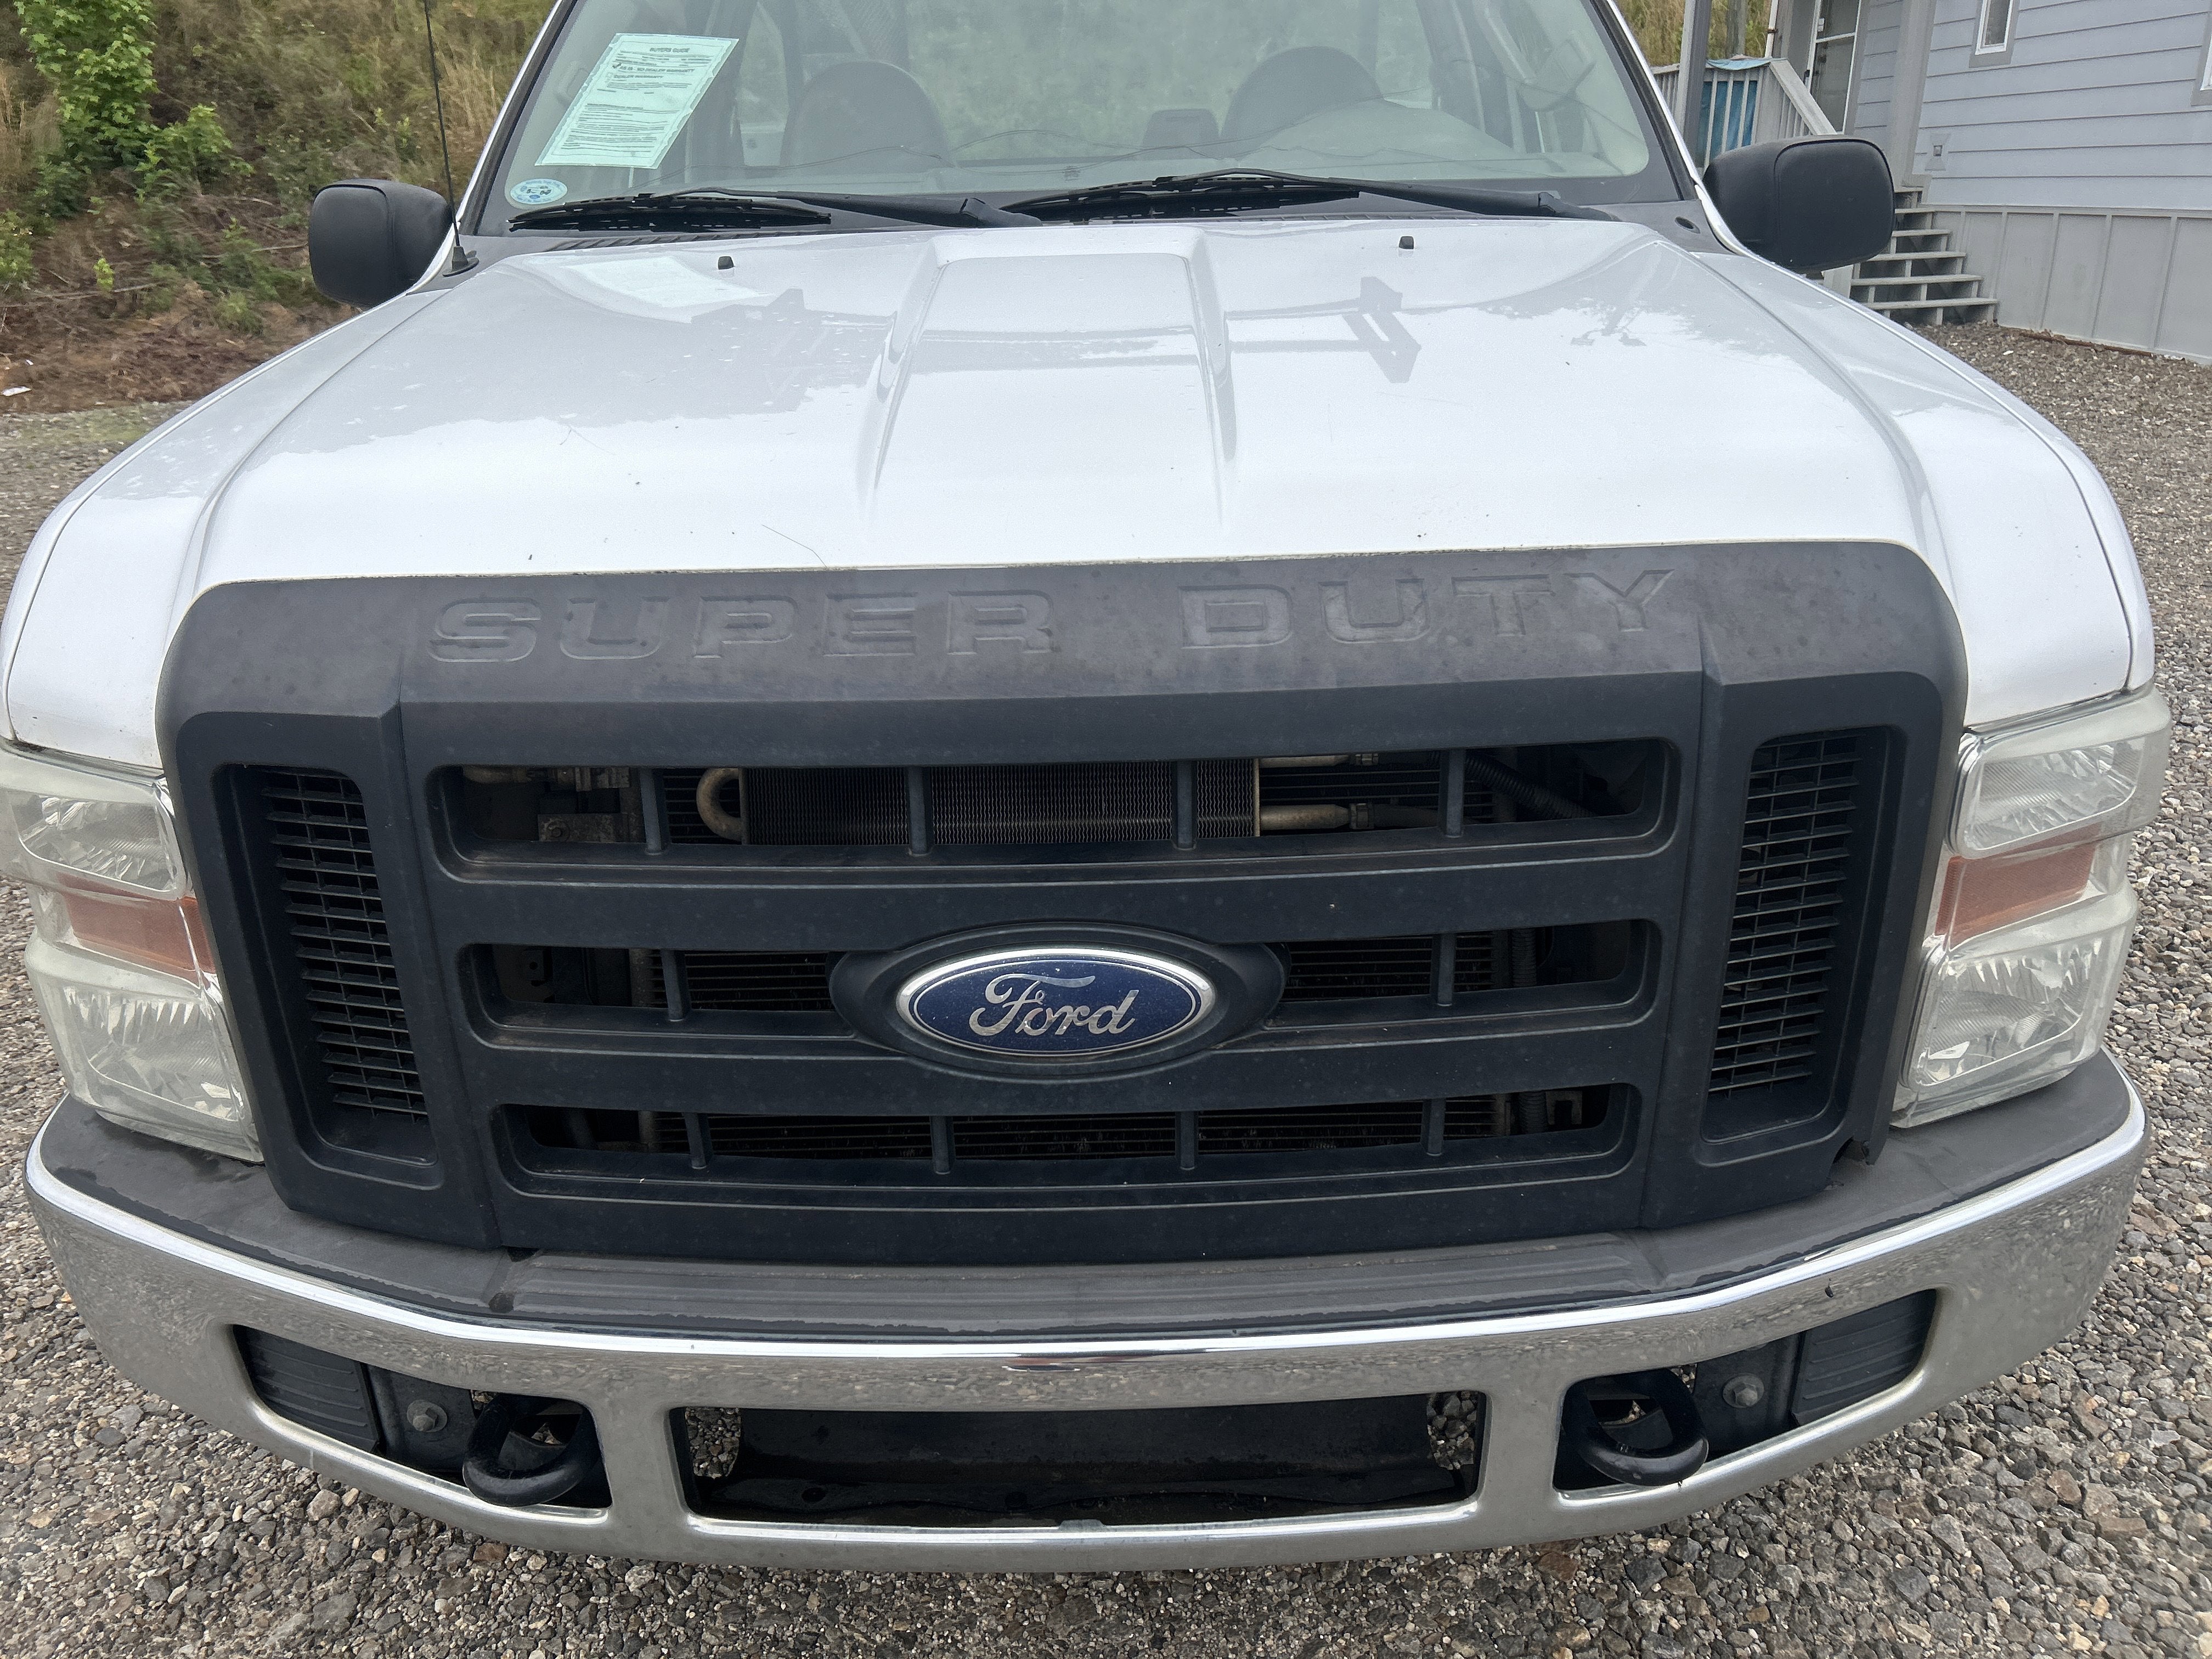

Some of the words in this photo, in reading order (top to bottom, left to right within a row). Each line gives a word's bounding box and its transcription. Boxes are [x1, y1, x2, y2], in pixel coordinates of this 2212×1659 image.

[427, 589, 1053, 663] SUPER
[1178, 568, 1675, 649] DUTY
[969, 973, 1139, 1036] Ford
